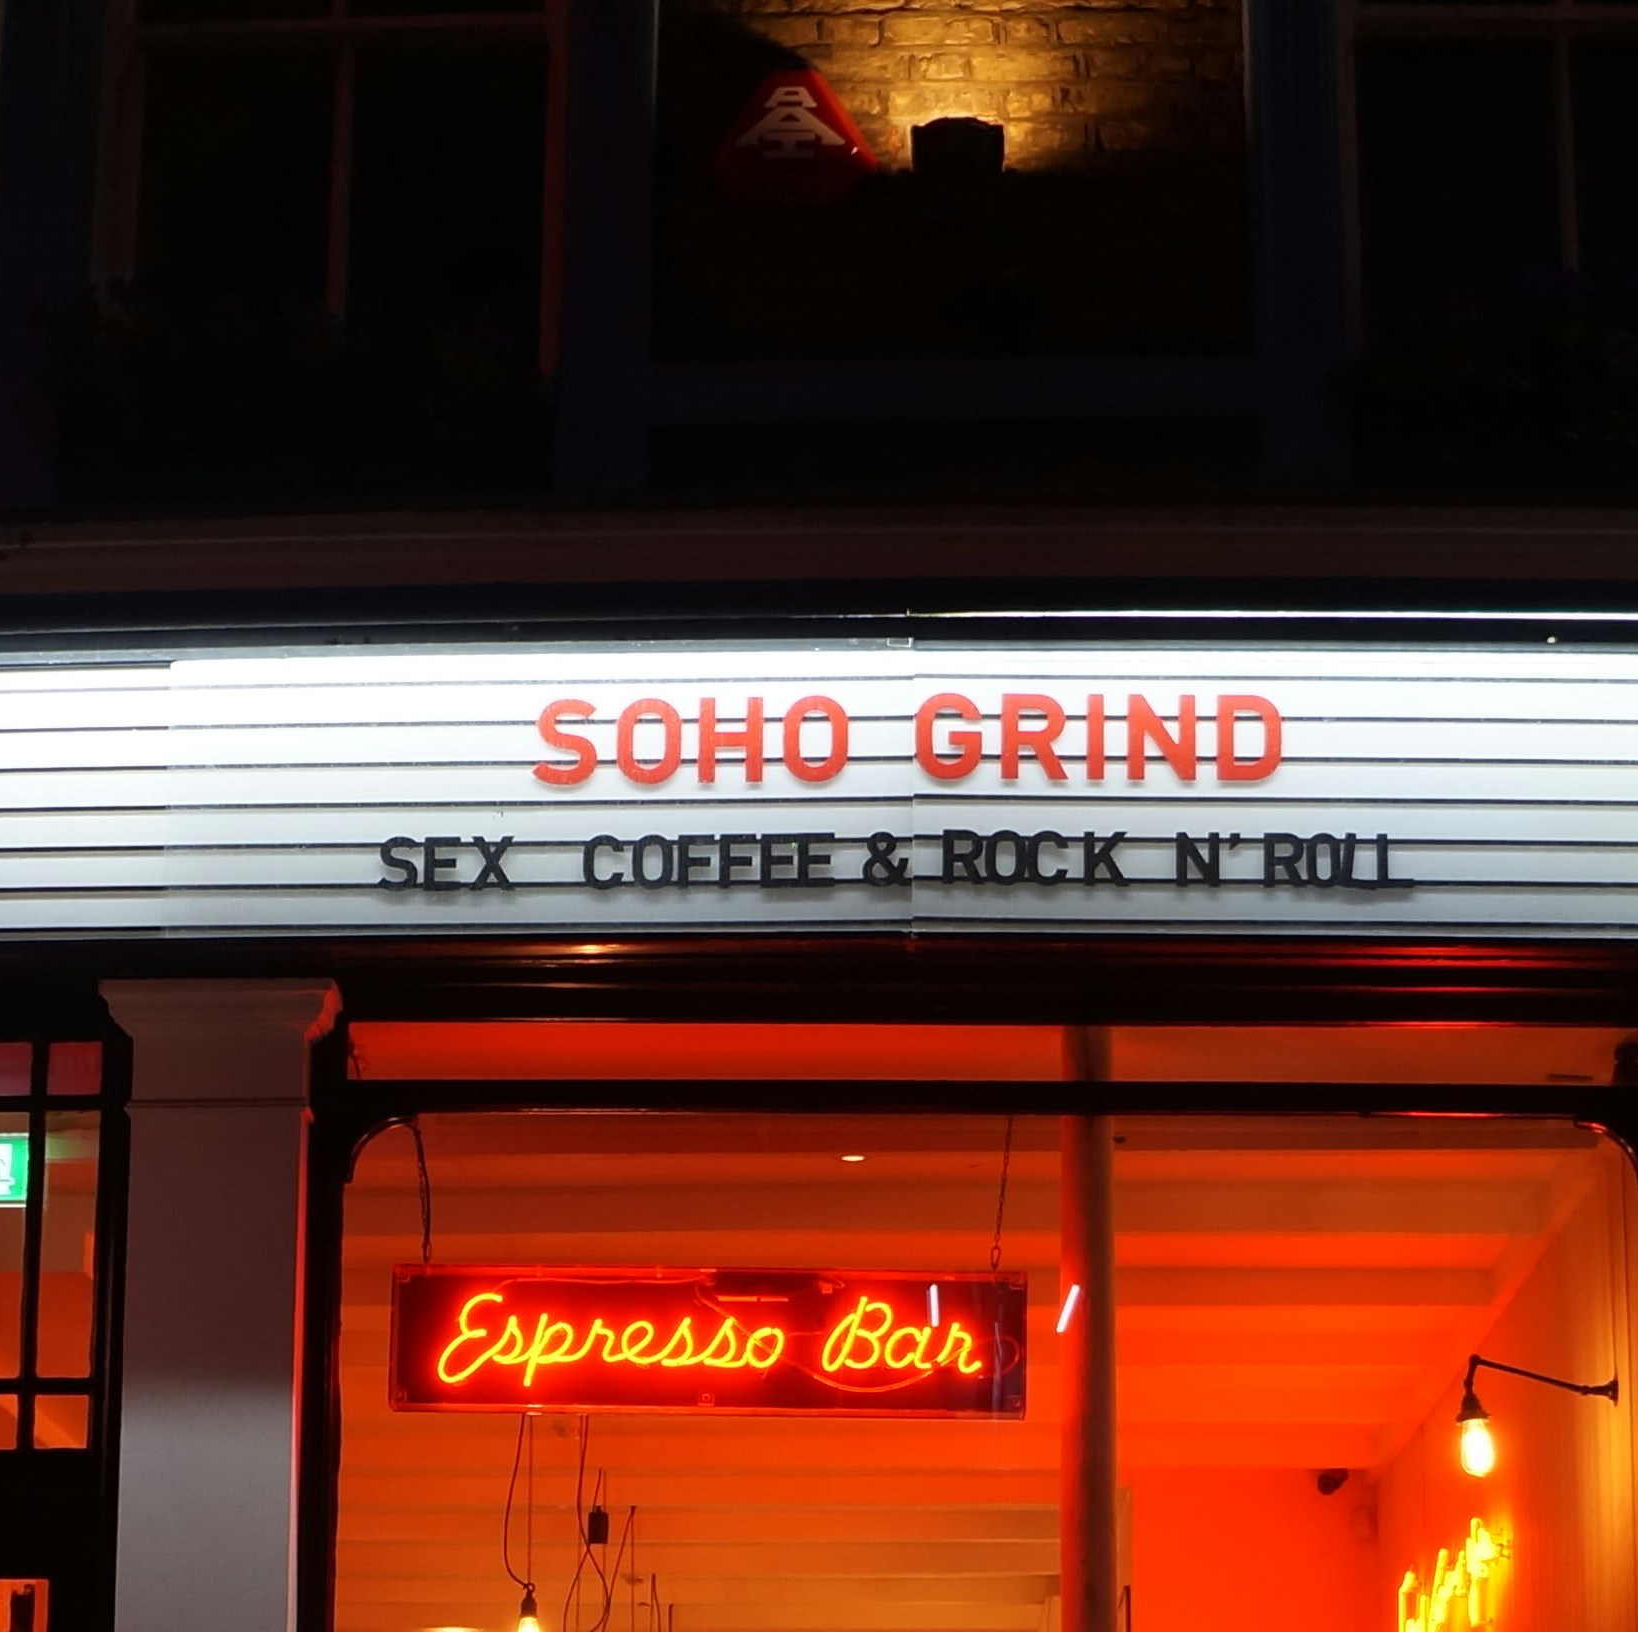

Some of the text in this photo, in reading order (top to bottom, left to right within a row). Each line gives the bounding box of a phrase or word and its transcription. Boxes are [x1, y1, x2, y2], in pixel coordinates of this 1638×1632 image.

[531, 691, 1283, 787] SOHO GRIND
[378, 836, 516, 892] SEX
[582, 831, 836, 891] COFFEE
[863, 830, 913, 888] &
[941, 828, 1130, 888] ROCK
[1263, 831, 1416, 891] ROLL
[436, 1291, 984, 1387] Espresso Bar
